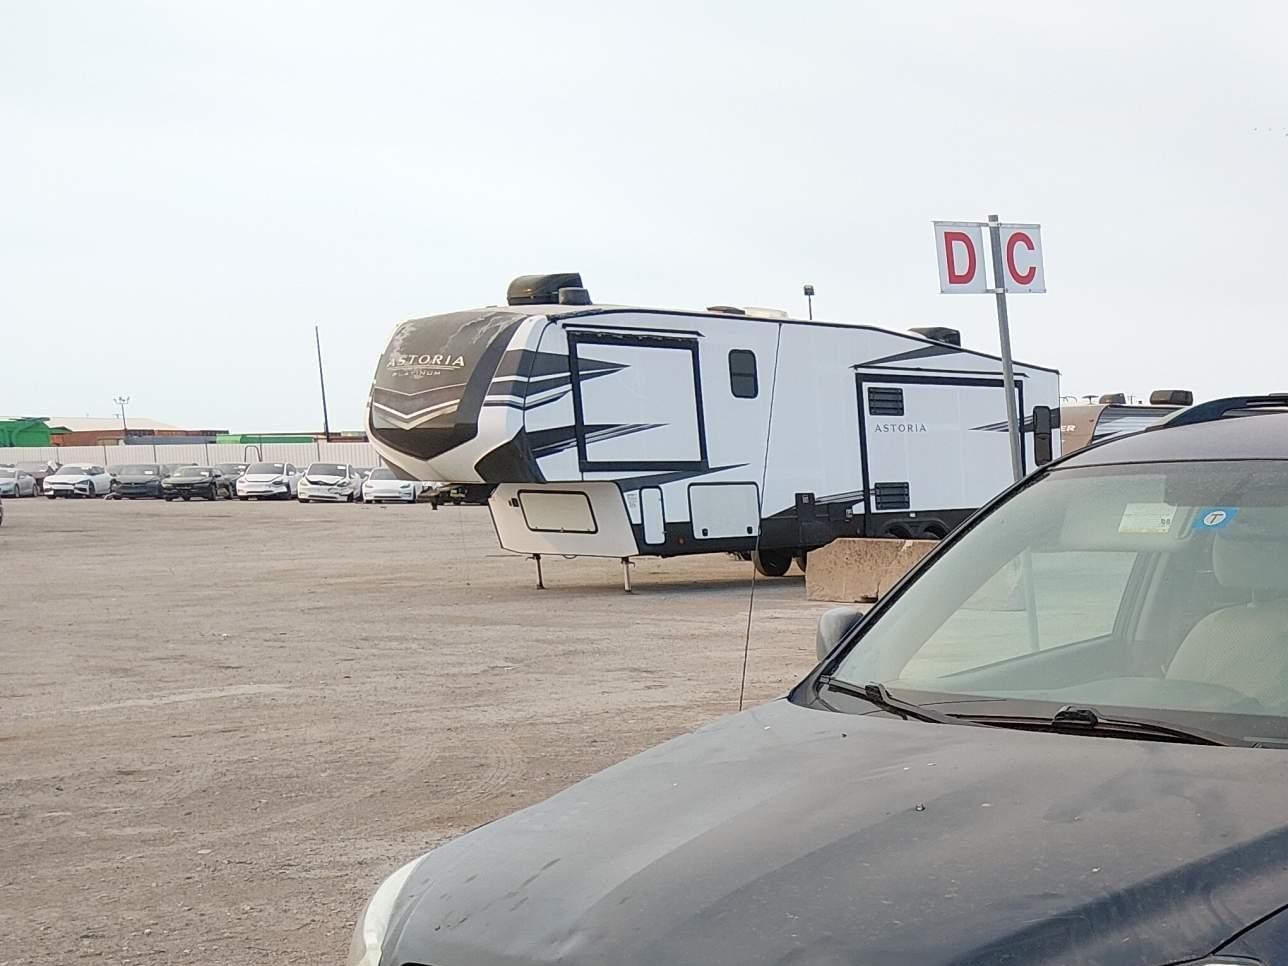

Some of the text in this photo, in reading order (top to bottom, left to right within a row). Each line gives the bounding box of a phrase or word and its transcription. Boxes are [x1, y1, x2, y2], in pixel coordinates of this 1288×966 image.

[943, 231, 977, 285] D
[1006, 231, 1037, 286] C
[386, 354, 465, 368] ASTORIA
[874, 423, 927, 433] ASTORIA
